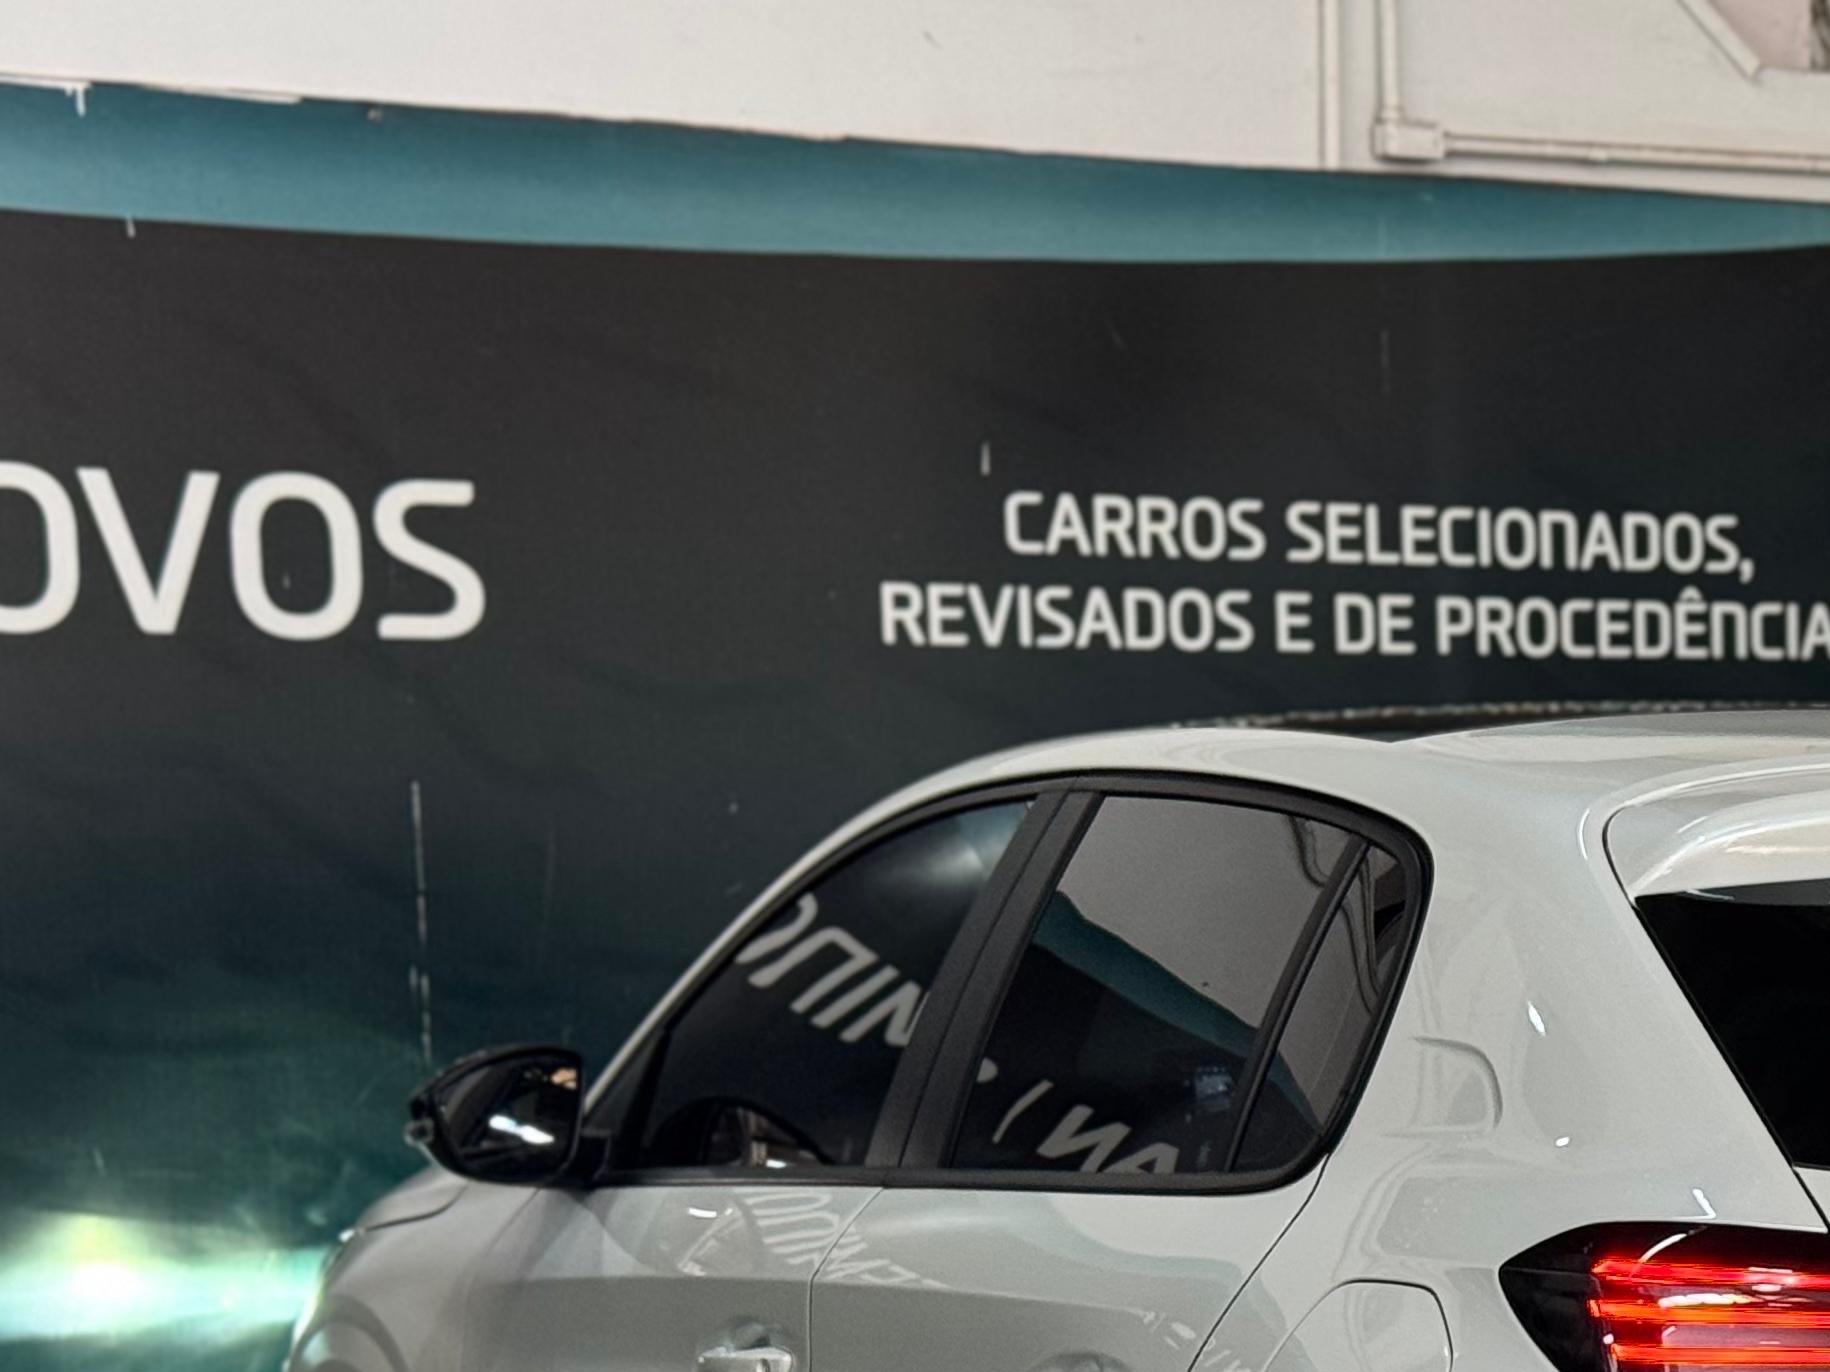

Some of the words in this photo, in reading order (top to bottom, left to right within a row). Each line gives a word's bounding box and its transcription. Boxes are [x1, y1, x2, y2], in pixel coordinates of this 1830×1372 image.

[1005, 492, 1266, 560] CARROS
[1286, 501, 1753, 583] SELECIONADOS,
[880, 581, 1253, 651] REVISADOS
[1276, 592, 1313, 652] E
[1335, 594, 1415, 654] DE
